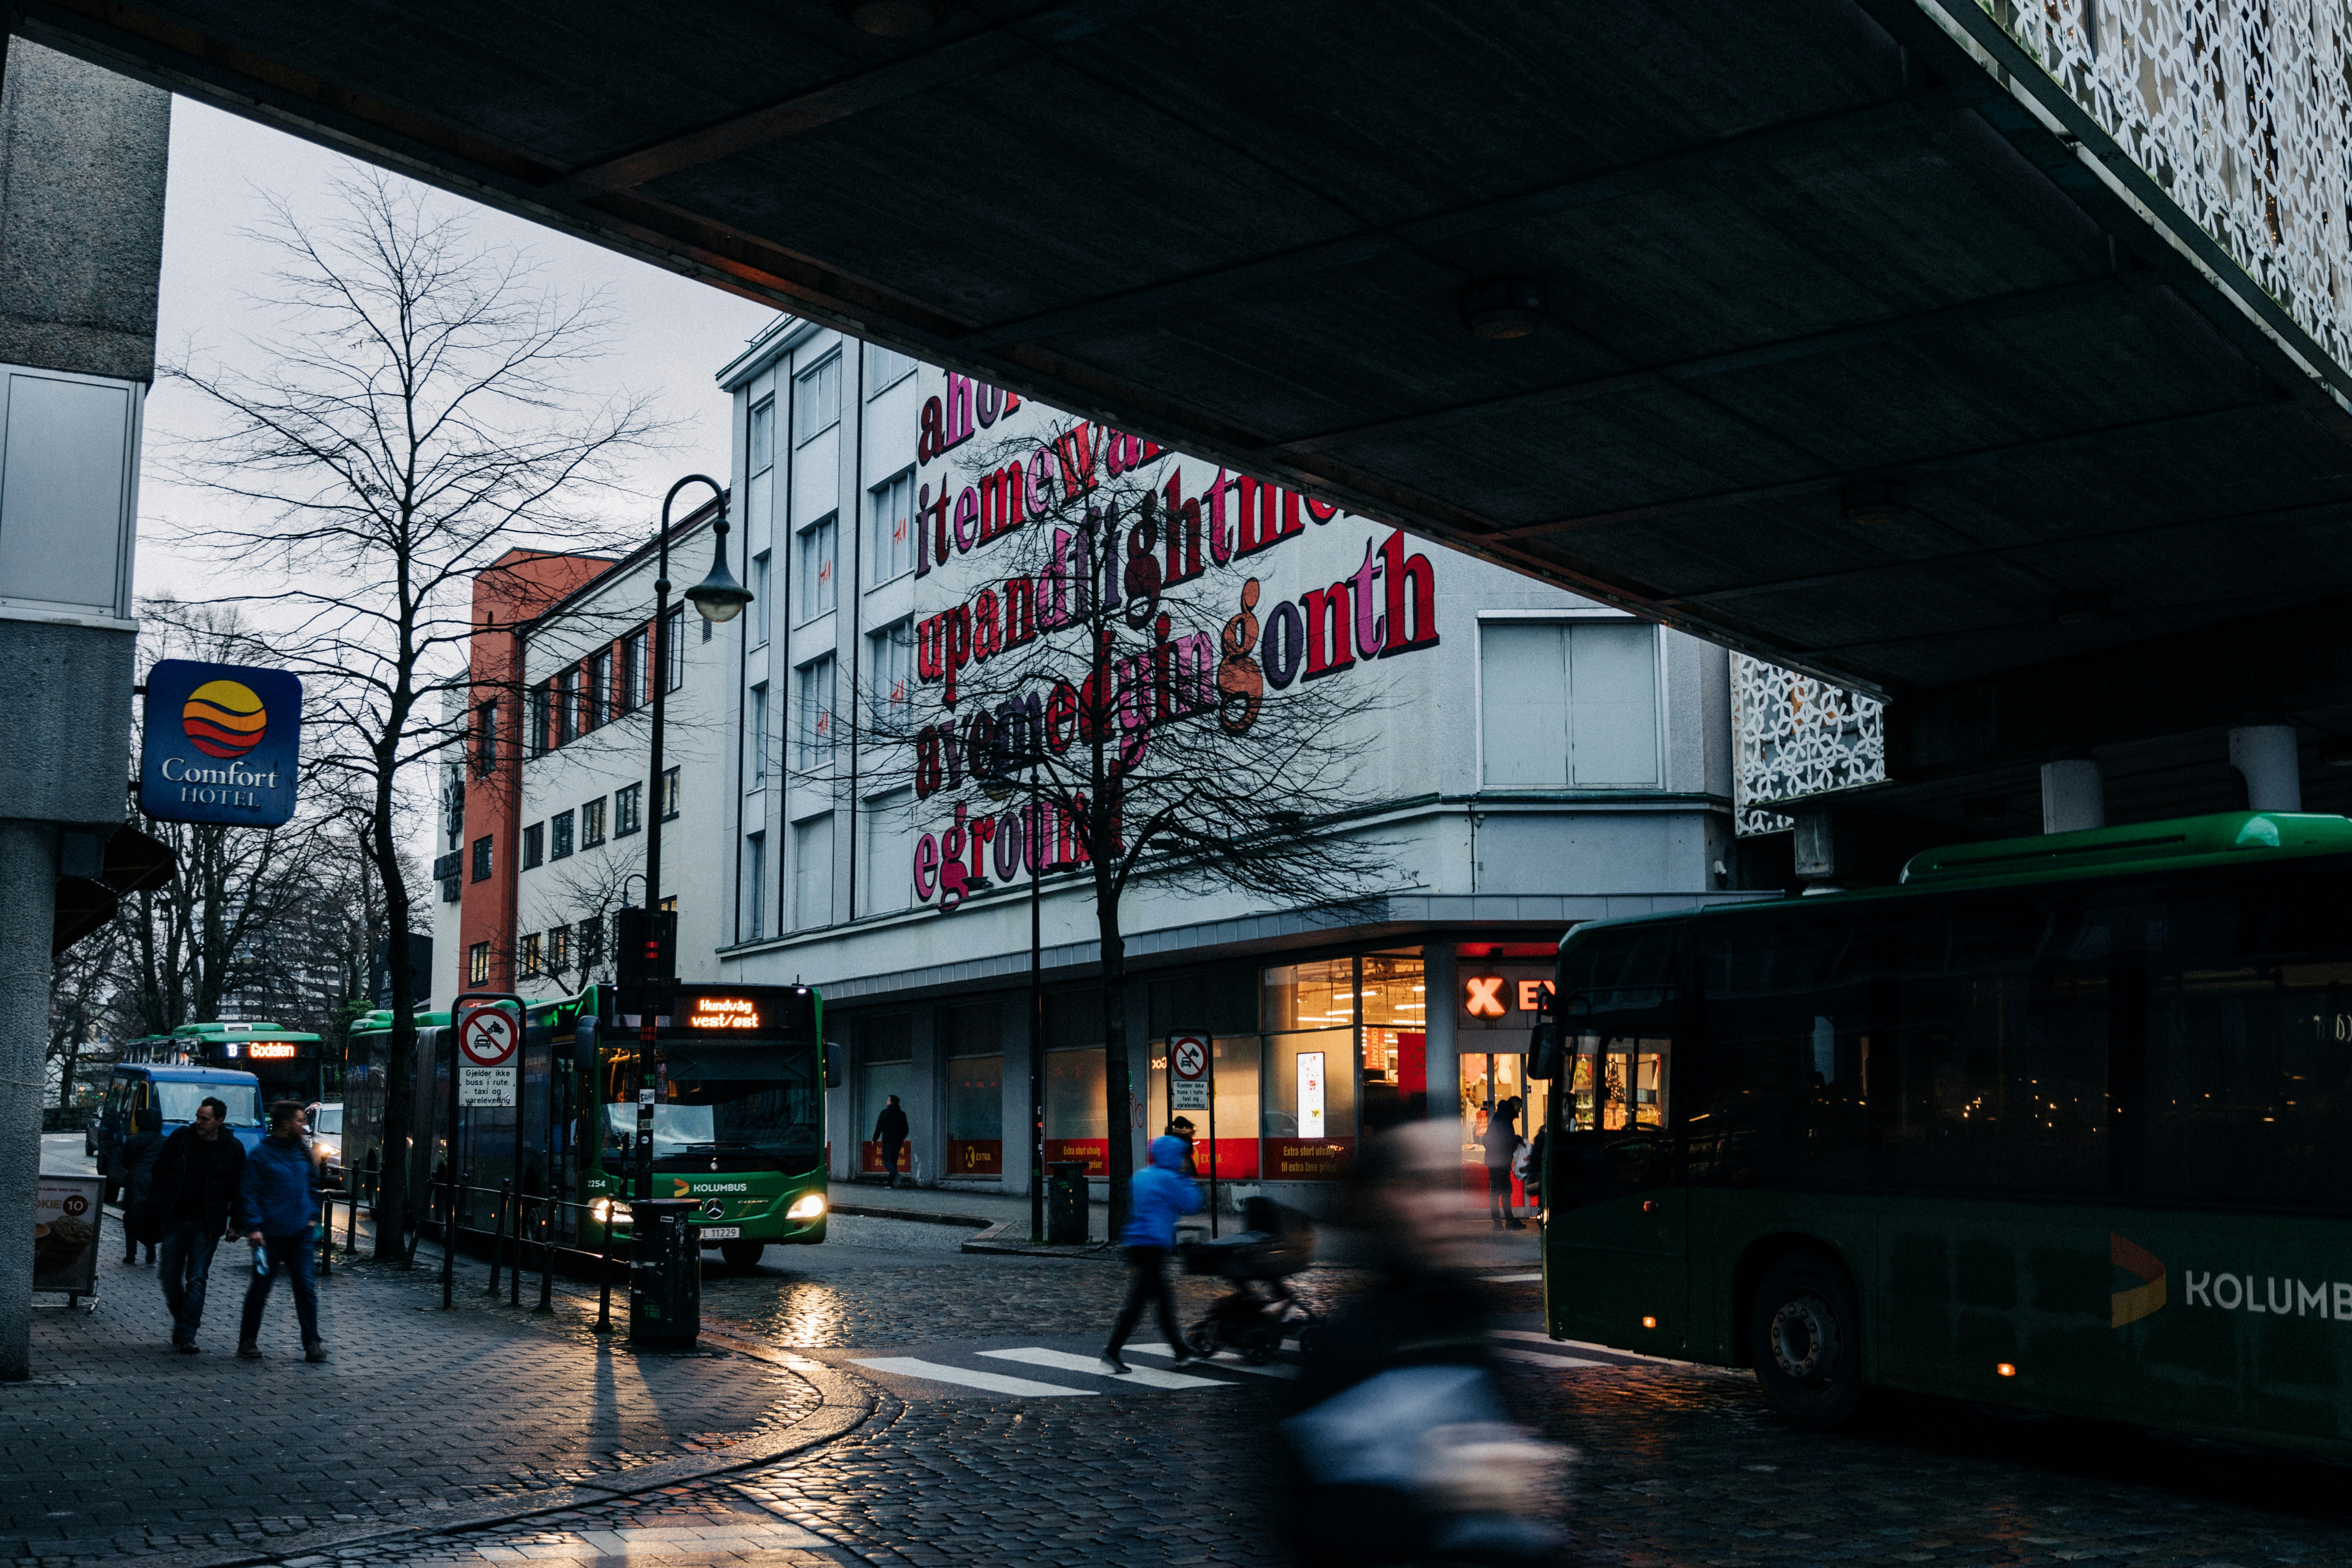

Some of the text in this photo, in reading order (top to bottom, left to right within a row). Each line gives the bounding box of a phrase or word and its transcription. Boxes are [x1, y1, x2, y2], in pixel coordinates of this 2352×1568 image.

[162, 758, 279, 789] Comfort
[181, 788, 260, 807] HOTEL
[700, 1000, 752, 1014] Hundvåg
[692, 1013, 759, 1027] vest/øst
[251, 1042, 295, 1057] Godalen
[466, 1070, 491, 1078] Gjelder
[976, 1153, 991, 1161] EXTRA
[1063, 1146, 1101, 1157] Extra stort utvalg
[1283, 1146, 1335, 1158] Extra stort utvalg
[1201, 1153, 1222, 1164] EXA
[1089, 1159, 1102, 1171] priser
[1289, 1161, 1304, 1172] extra
[1305, 1161, 1318, 1172] lave
[693, 1183, 747, 1192] KOLUMBUS
[67, 1200, 84, 1211] 10
[712, 1228, 736, 1237] 11229
[2185, 1269, 2352, 1321] KOLUMB
